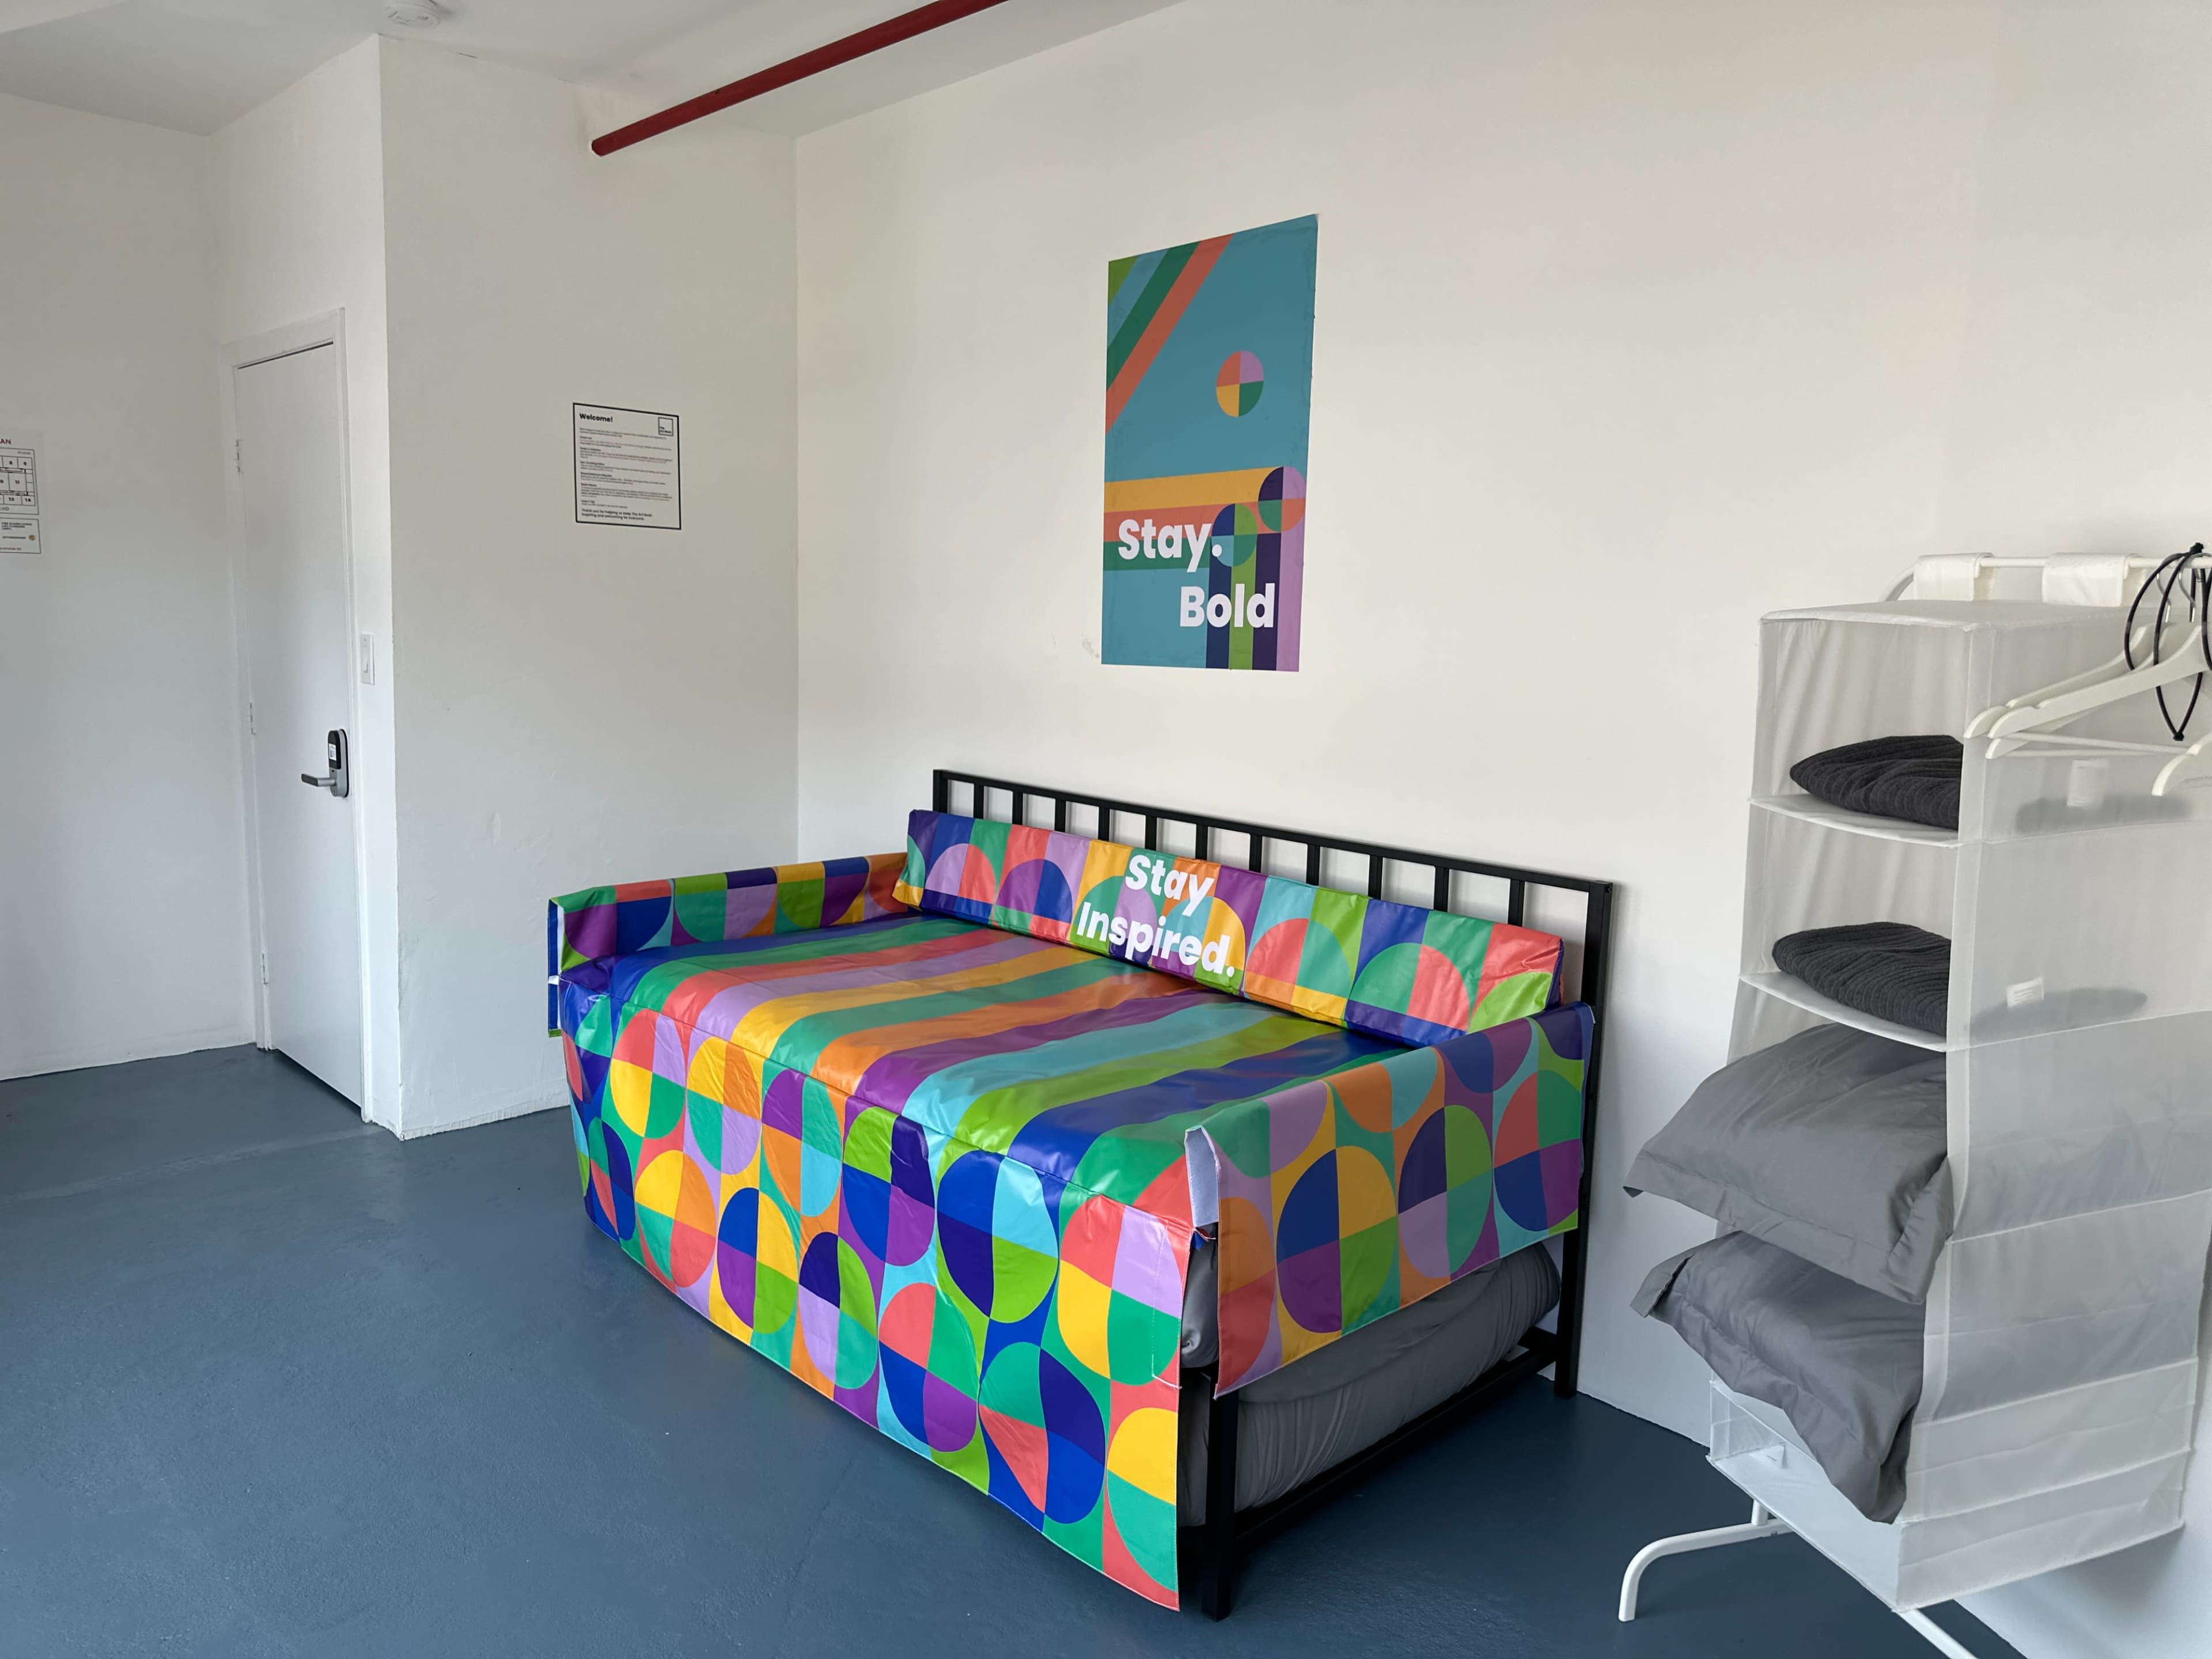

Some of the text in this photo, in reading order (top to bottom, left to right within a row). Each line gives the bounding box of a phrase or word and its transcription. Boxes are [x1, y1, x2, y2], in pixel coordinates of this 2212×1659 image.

[579, 413, 613, 422] Welcome!
[1118, 518, 1222, 573] Stay.
[1179, 582, 1275, 628] Bold
[1125, 855, 1214, 916] Stay
[1076, 902, 1234, 977] Inspired.
